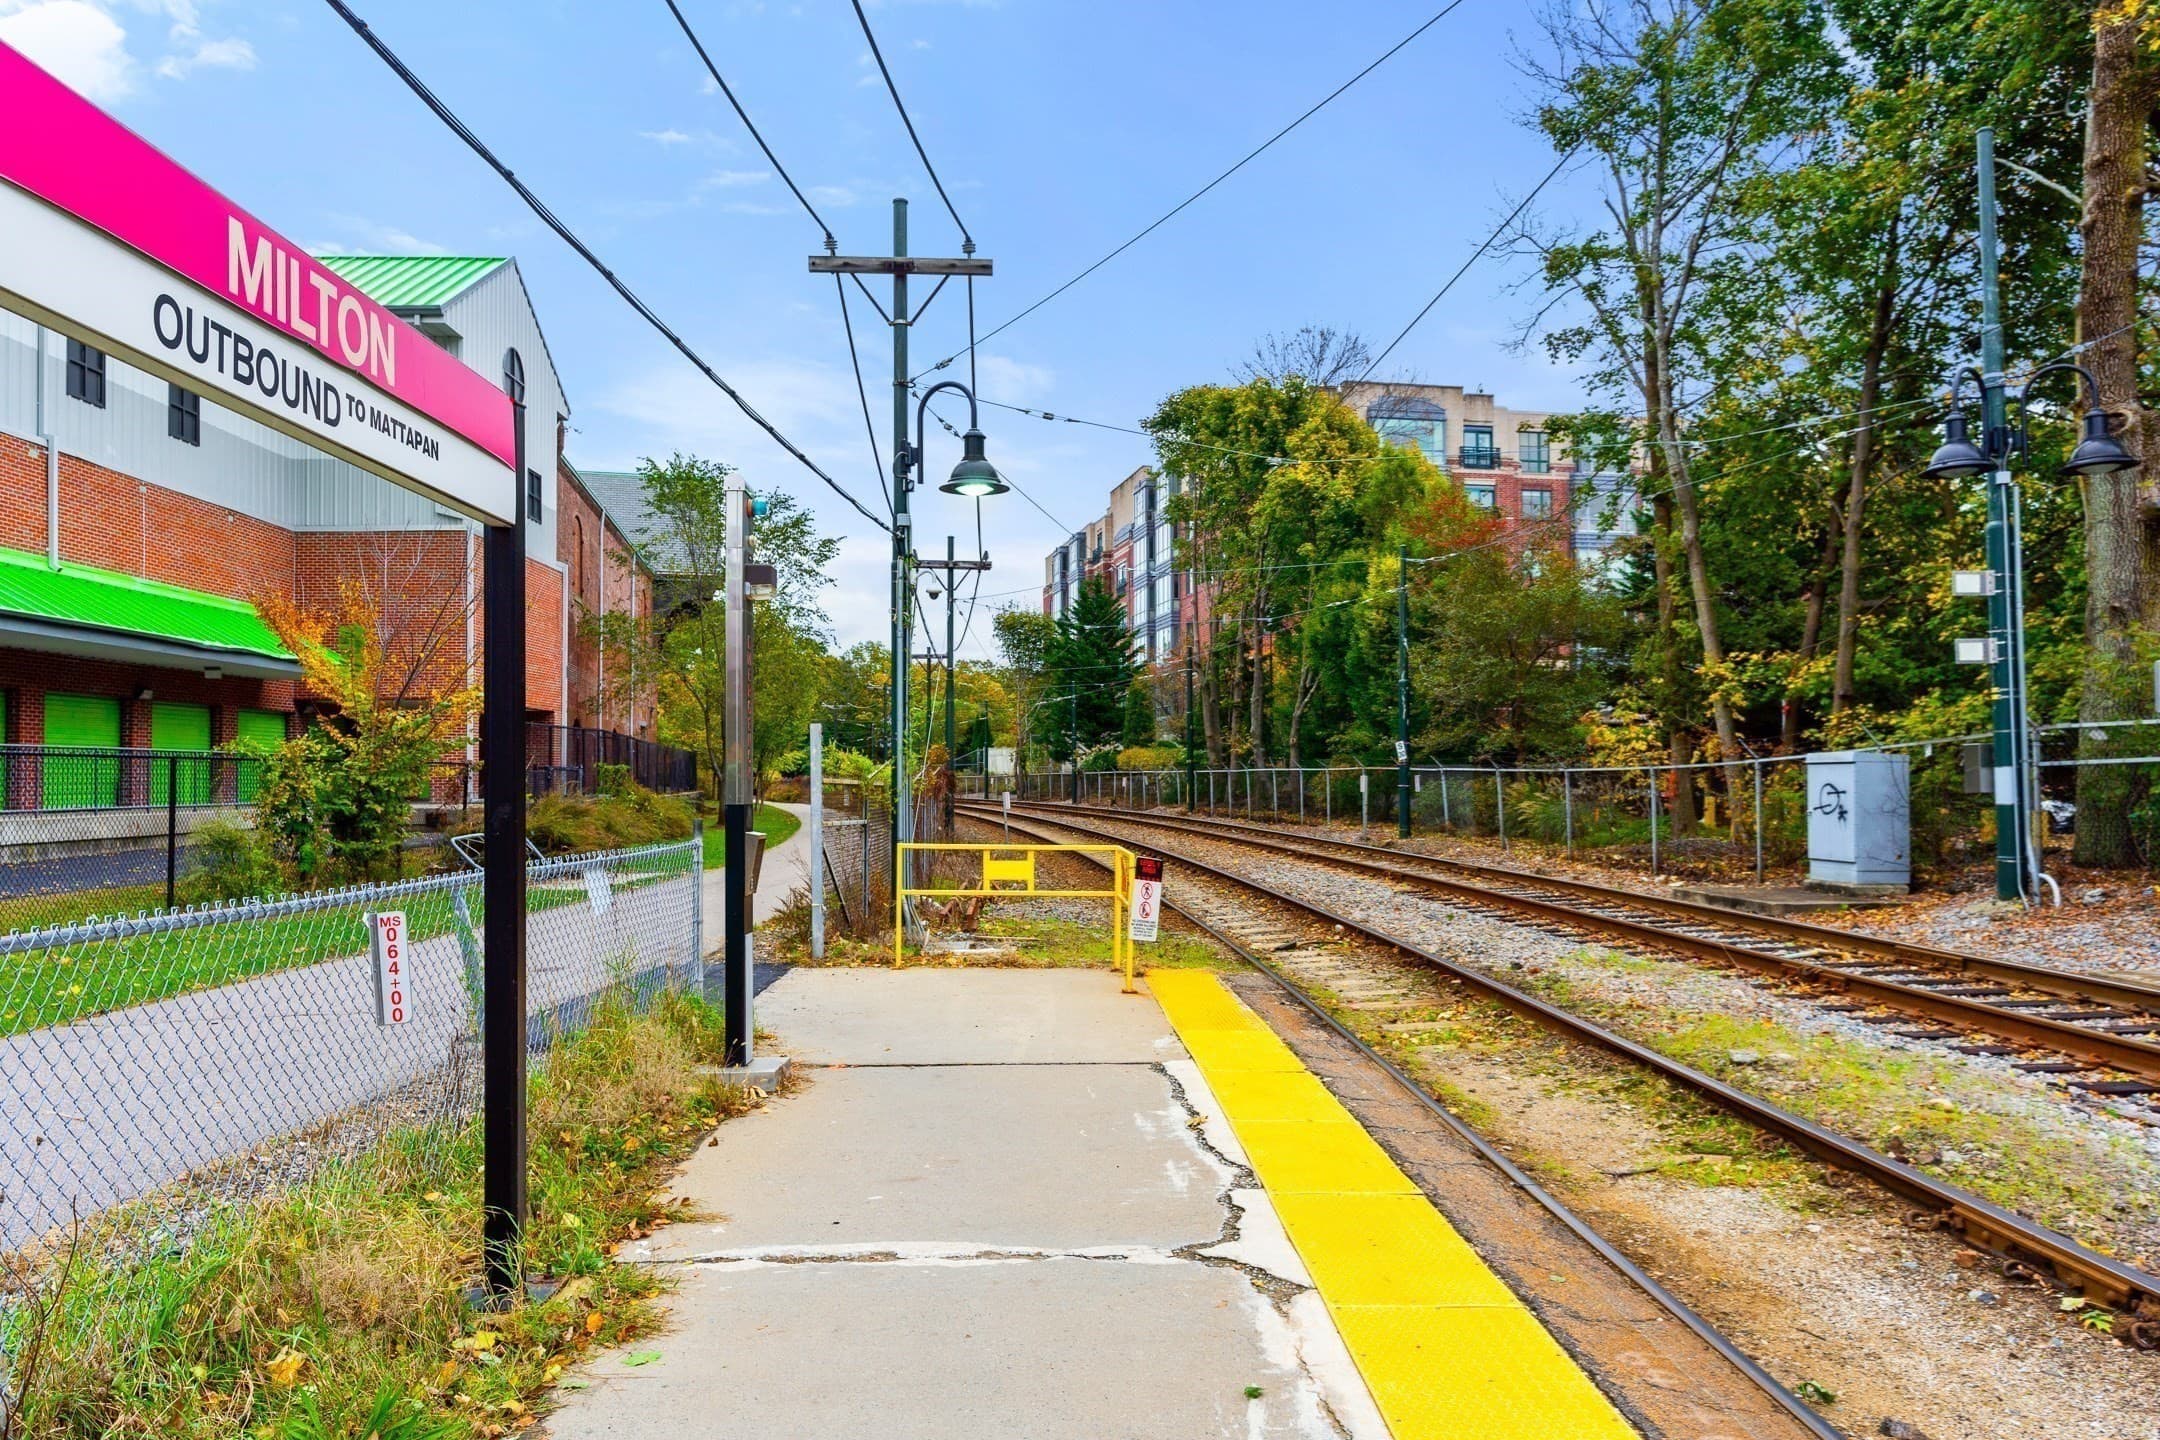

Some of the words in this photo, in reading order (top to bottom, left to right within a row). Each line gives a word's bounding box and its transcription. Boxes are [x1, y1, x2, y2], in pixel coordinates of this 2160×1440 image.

[153, 293, 341, 428] OUTBOUND
[345, 393, 366, 423] TO
[370, 406, 439, 461] MATTAPAN
[228, 215, 396, 388] MILTON
[380, 915, 401, 928] MS
